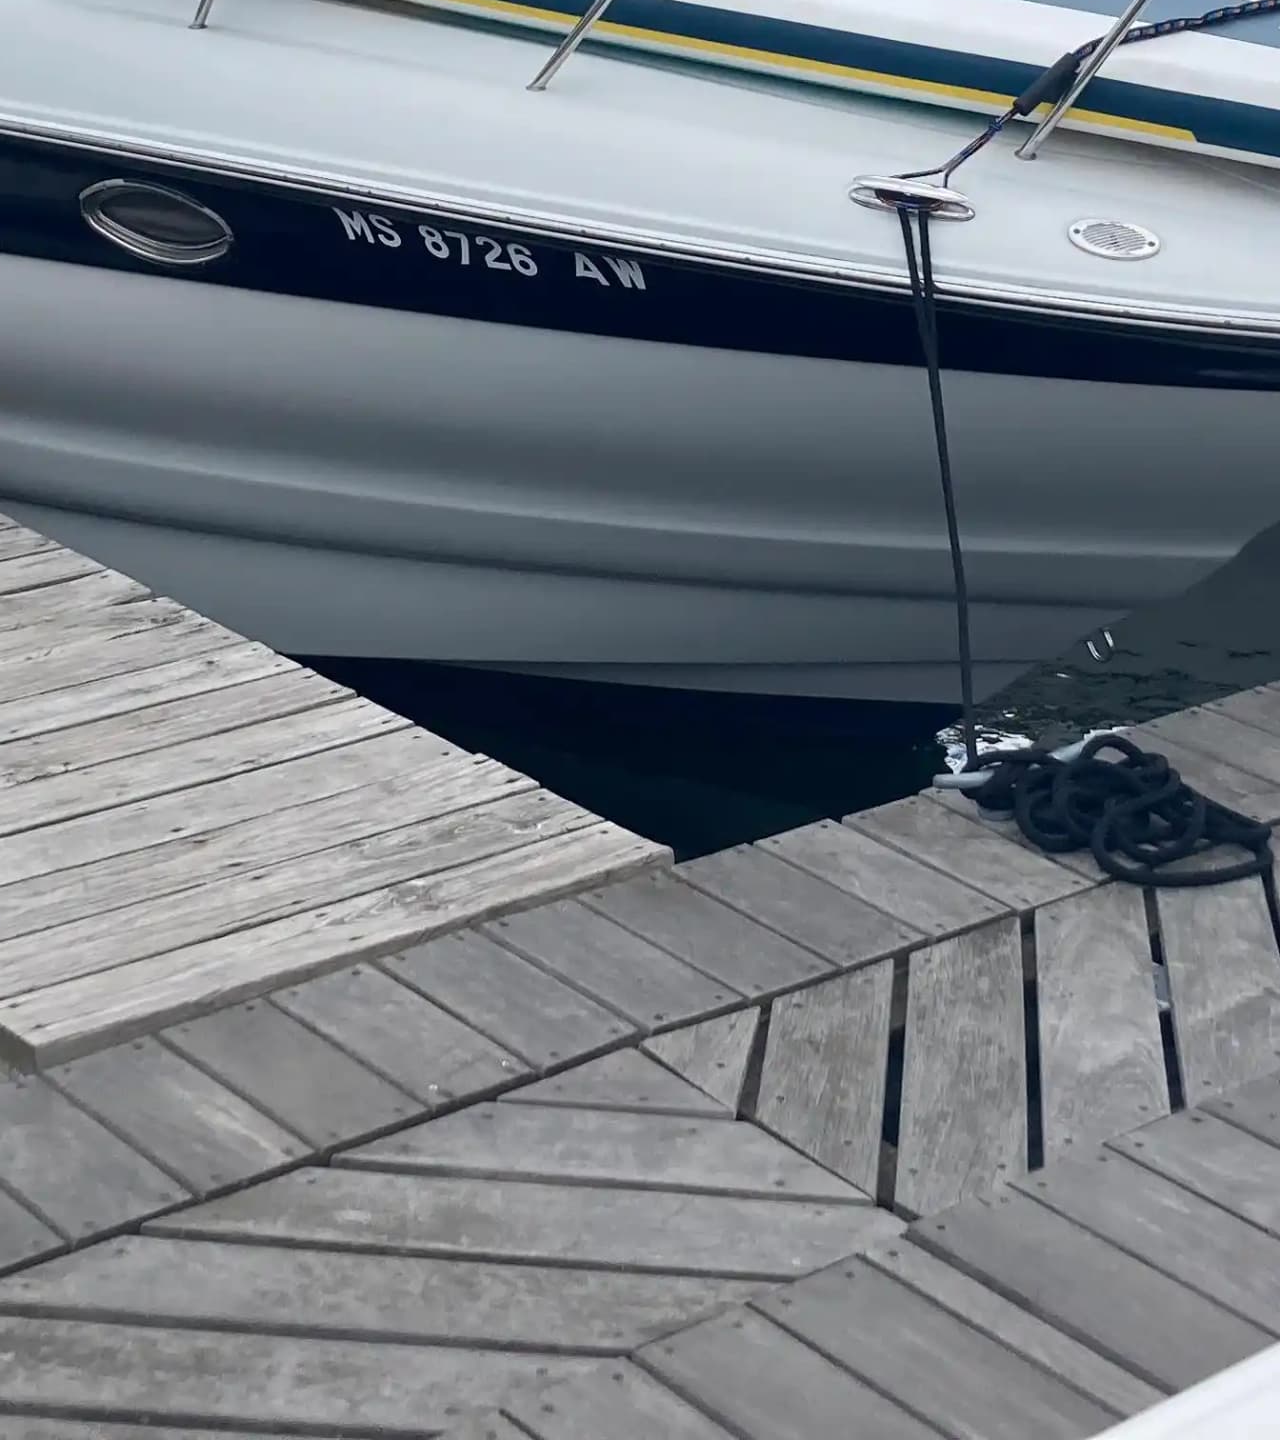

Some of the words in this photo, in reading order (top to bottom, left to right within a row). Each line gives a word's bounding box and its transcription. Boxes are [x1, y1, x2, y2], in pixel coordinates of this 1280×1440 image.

[332, 207, 402, 248] MS
[418, 224, 539, 277] 8726
[574, 252, 647, 290] AW
